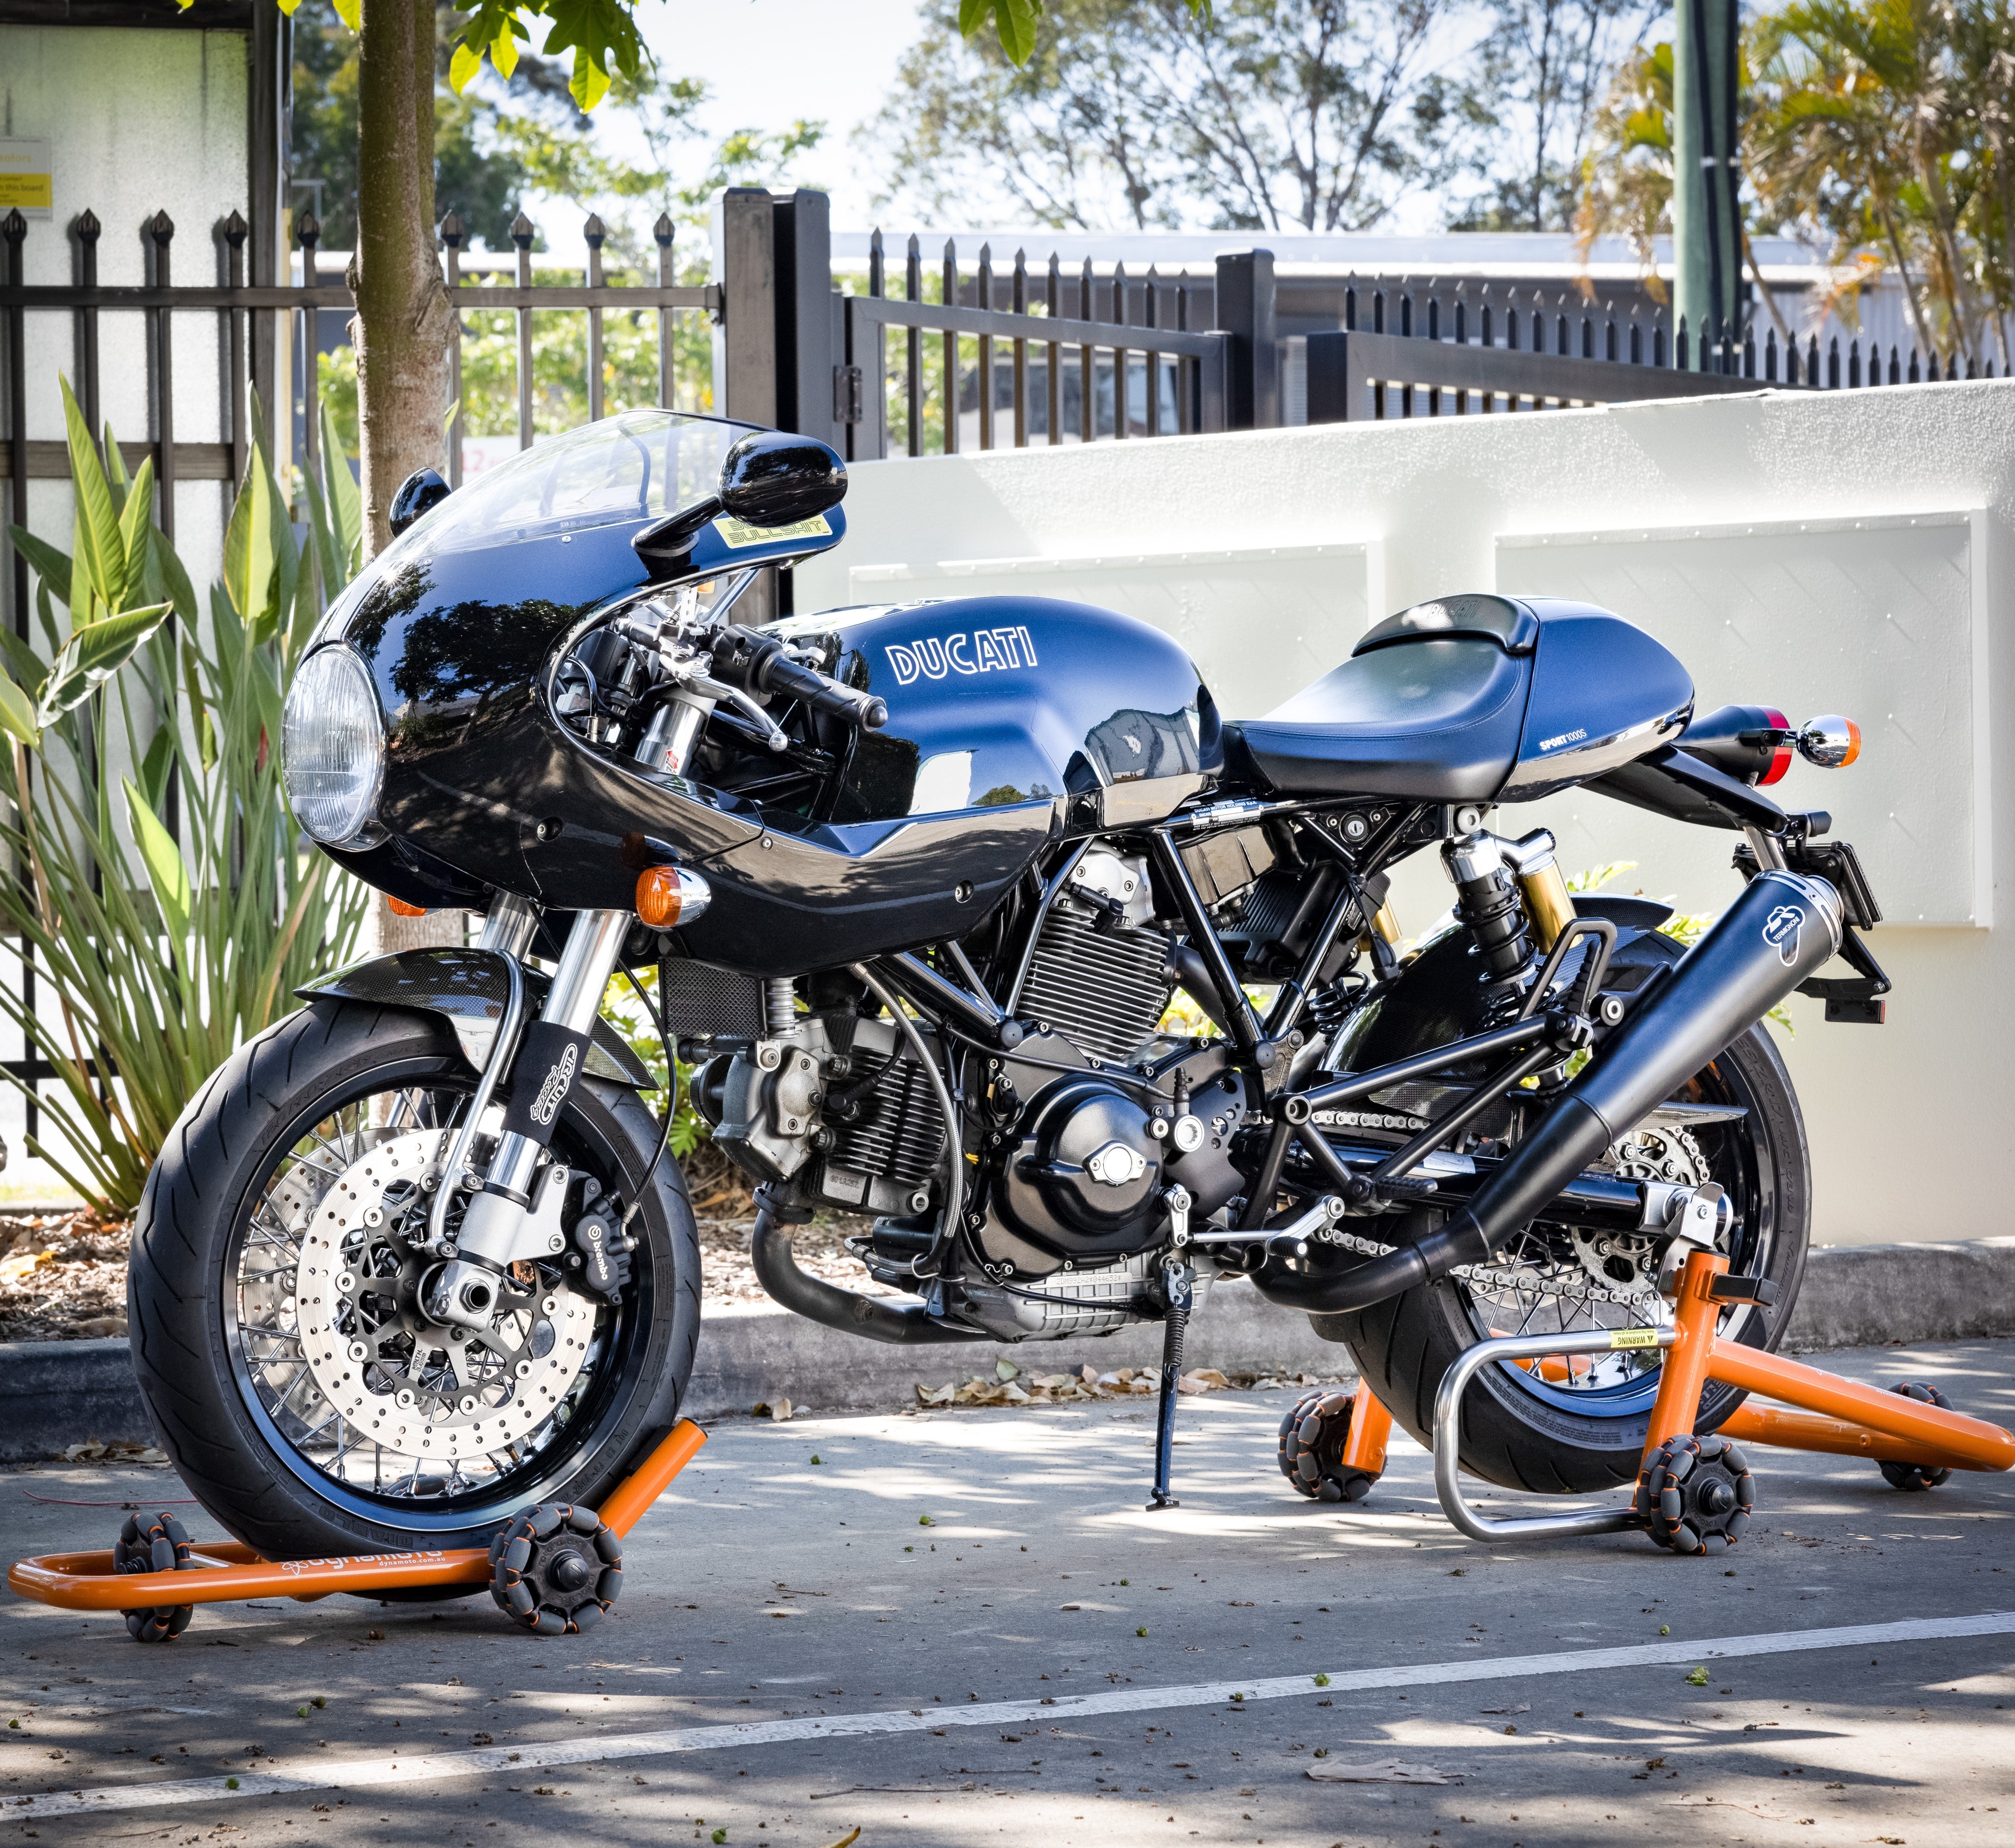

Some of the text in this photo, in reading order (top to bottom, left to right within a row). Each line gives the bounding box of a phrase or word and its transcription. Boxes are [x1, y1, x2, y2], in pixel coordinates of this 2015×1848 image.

[884, 626, 1038, 685] DUCATI
[1773, 916, 1800, 941] TERMIGNONI
[540, 1044, 577, 1123] CIRCUIT
[593, 1240, 608, 1280] brembo
[1618, 1336, 1646, 1345] WARNING
[416, 1353, 426, 1372] 3.6mm
[236, 1411, 291, 1488] ROSSO
[319, 1505, 414, 1548] DIABLO
[378, 1557, 446, 1566] dynamoto.com.au
